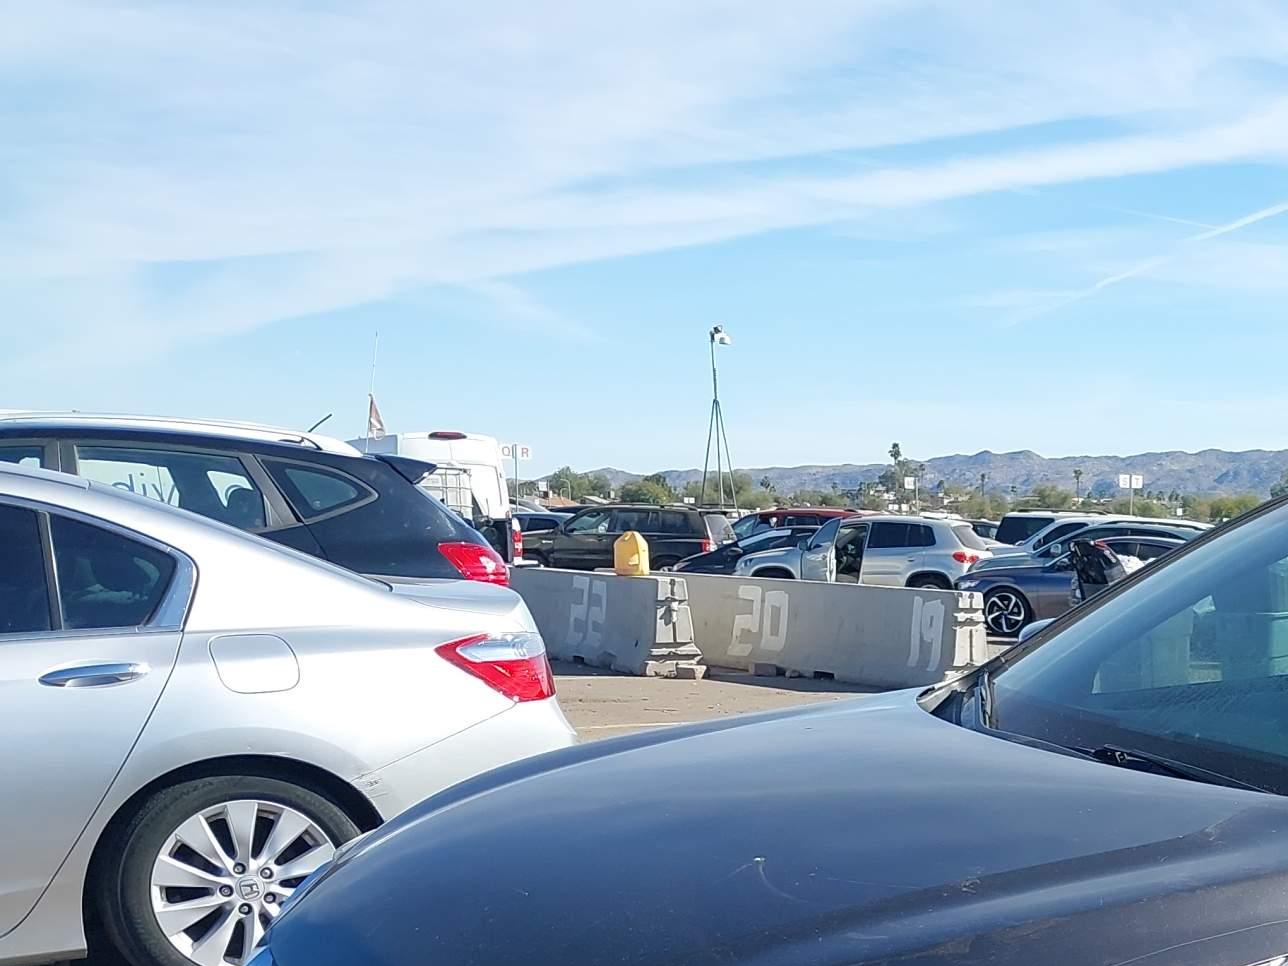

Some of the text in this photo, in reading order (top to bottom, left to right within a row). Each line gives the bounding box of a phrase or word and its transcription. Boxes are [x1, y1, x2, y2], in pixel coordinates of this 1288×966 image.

[521, 447, 529, 458] R
[727, 585, 789, 656] 20
[908, 596, 944, 671] 19
